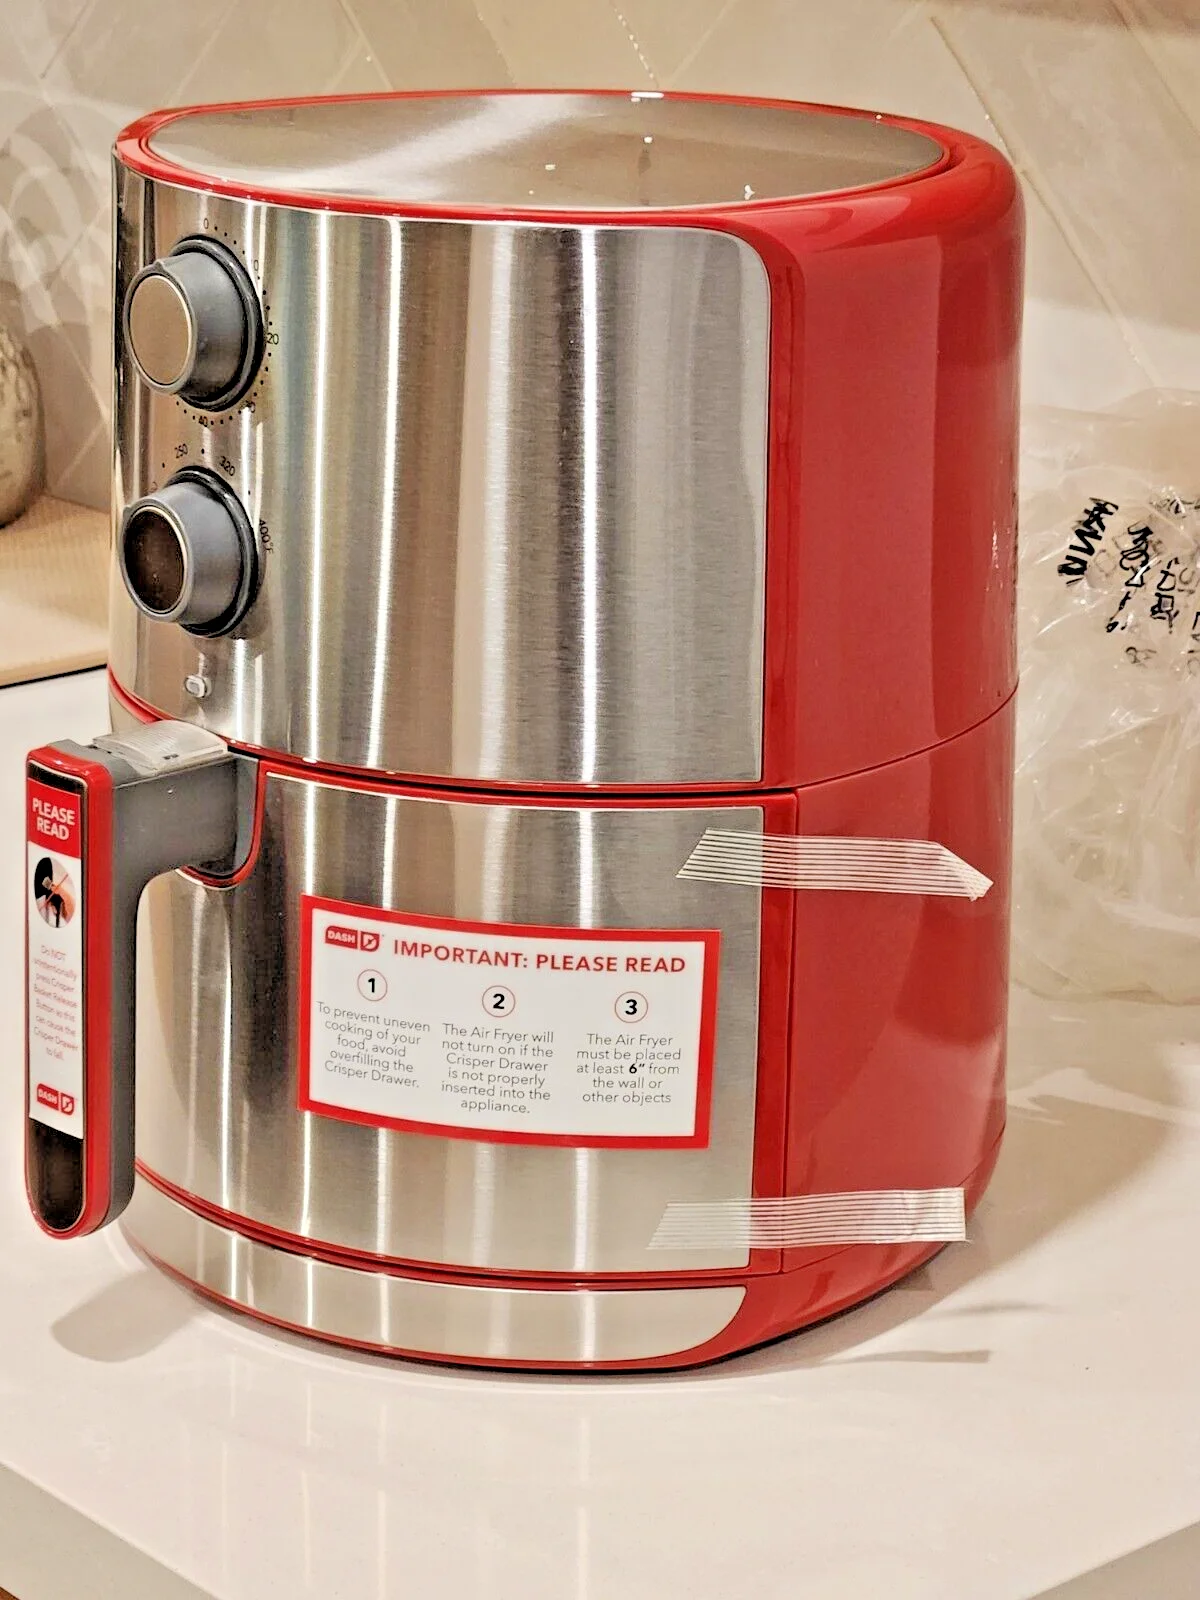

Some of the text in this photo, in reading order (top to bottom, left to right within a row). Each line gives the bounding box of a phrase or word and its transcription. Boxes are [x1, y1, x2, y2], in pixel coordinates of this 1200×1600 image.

[203, 218, 209, 229] 0
[266, 332, 279, 345] 20
[219, 455, 236, 477] 320
[32, 797, 76, 826] PLEASE
[36, 816, 70, 840] READ
[326, 929, 356, 945] DASH
[394, 939, 686, 973] IMPORTANT: PLEASE READ
[368, 978, 376, 993] 1
[493, 993, 506, 1010] 2
[625, 998, 638, 1016] 3
[316, 1000, 431, 1033] To prevent uneven
[325, 1020, 422, 1046] cooking of your
[442, 1022, 555, 1044] The Air Fryer will
[586, 1033, 674, 1049] The Air Fryer
[337, 1028, 407, 1058] food, avoid
[442, 1040, 554, 1058] not turn on if the
[330, 1050, 414, 1073] overfilling the
[446, 1052, 549, 1072] Crisper Drawer
[577, 1047, 682, 1063] must be placed
[324, 1060, 420, 1089] Crisper Drawer.
[576, 1063, 590, 1074] at
[592, 1061, 625, 1074] least
[648, 1062, 680, 1075] from
[448, 1066, 546, 1090] is not properly
[592, 1076, 664, 1089] the wall or
[441, 1080, 552, 1101] inserted into the
[582, 1090, 673, 1107] other objects
[460, 1099, 531, 1115] appliance.
